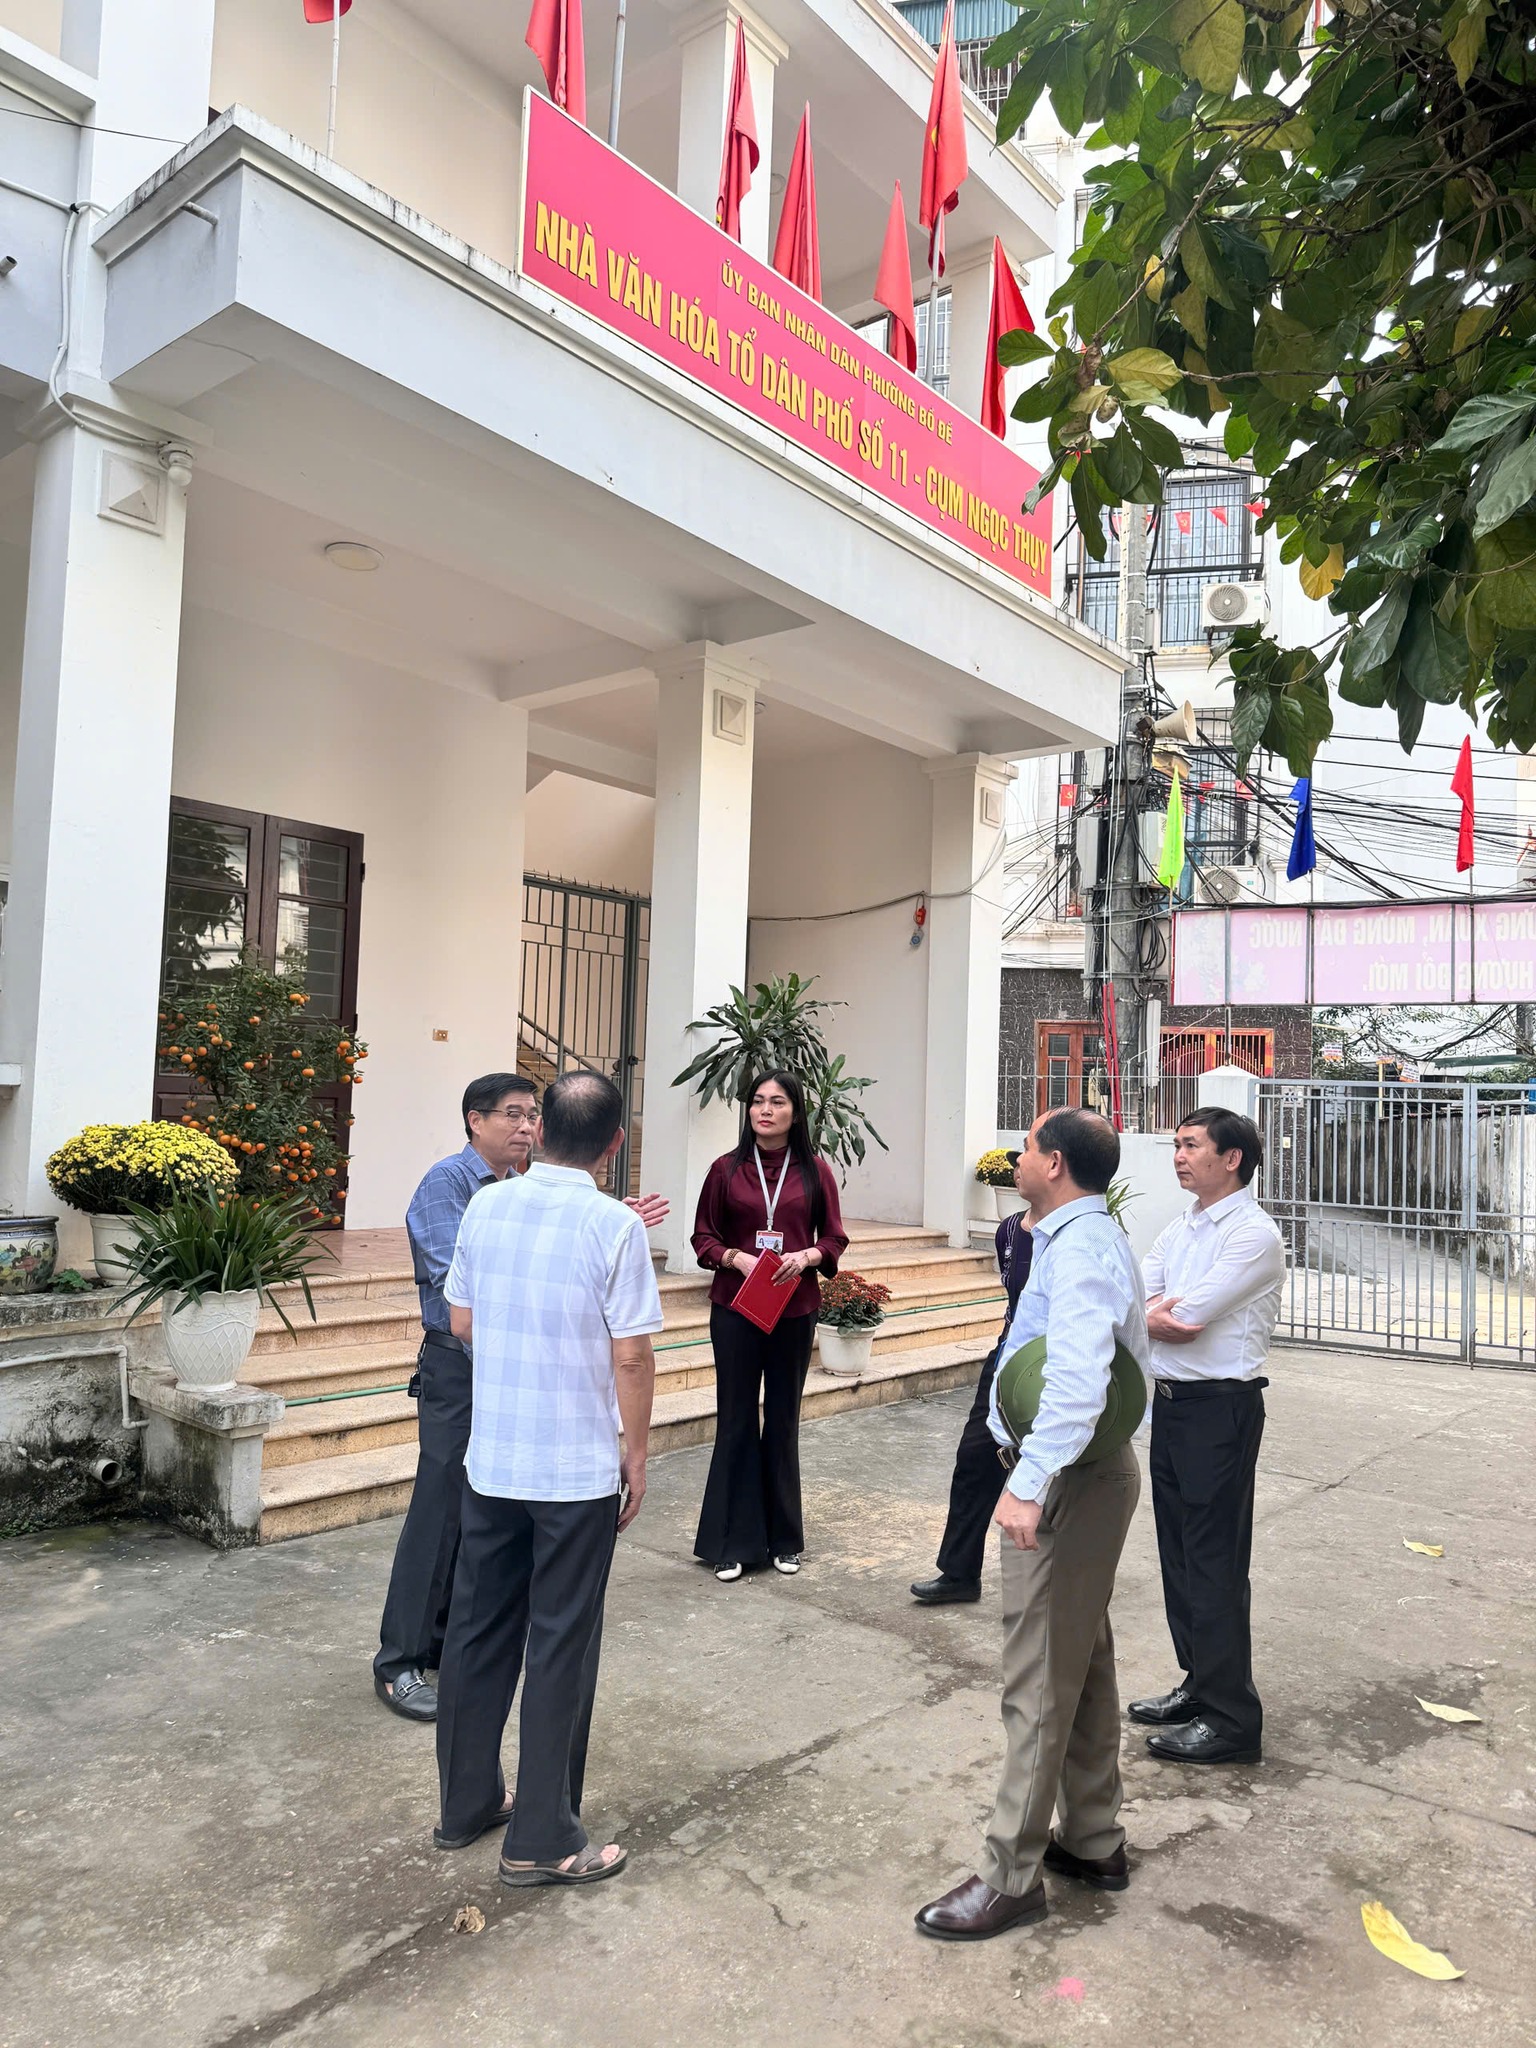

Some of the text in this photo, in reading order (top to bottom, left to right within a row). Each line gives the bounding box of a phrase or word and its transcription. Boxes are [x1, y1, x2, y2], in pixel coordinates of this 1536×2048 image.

[534, 201, 598, 289] NHÀ
[606, 247, 663, 330] VĂN
[669, 291, 721, 367] HÓA
[727, 327, 758, 388] TỔ
[760, 352, 807, 423] DÂN
[812, 386, 854, 450] PHỐ
[858, 417, 885, 471] SỐ
[889, 441, 907, 488] 11
[925, 465, 964, 525] CỤM
[968, 492, 1010, 552] NGỌC
[1012, 522, 1048, 577] THỤY
[721, 259, 743, 296] ỦY
[747, 281, 781, 325] BAN
[784, 310, 827, 358] NHÂN
[830, 346, 860, 380] DÂN
[863, 367, 916, 419] PHƯỜNG
